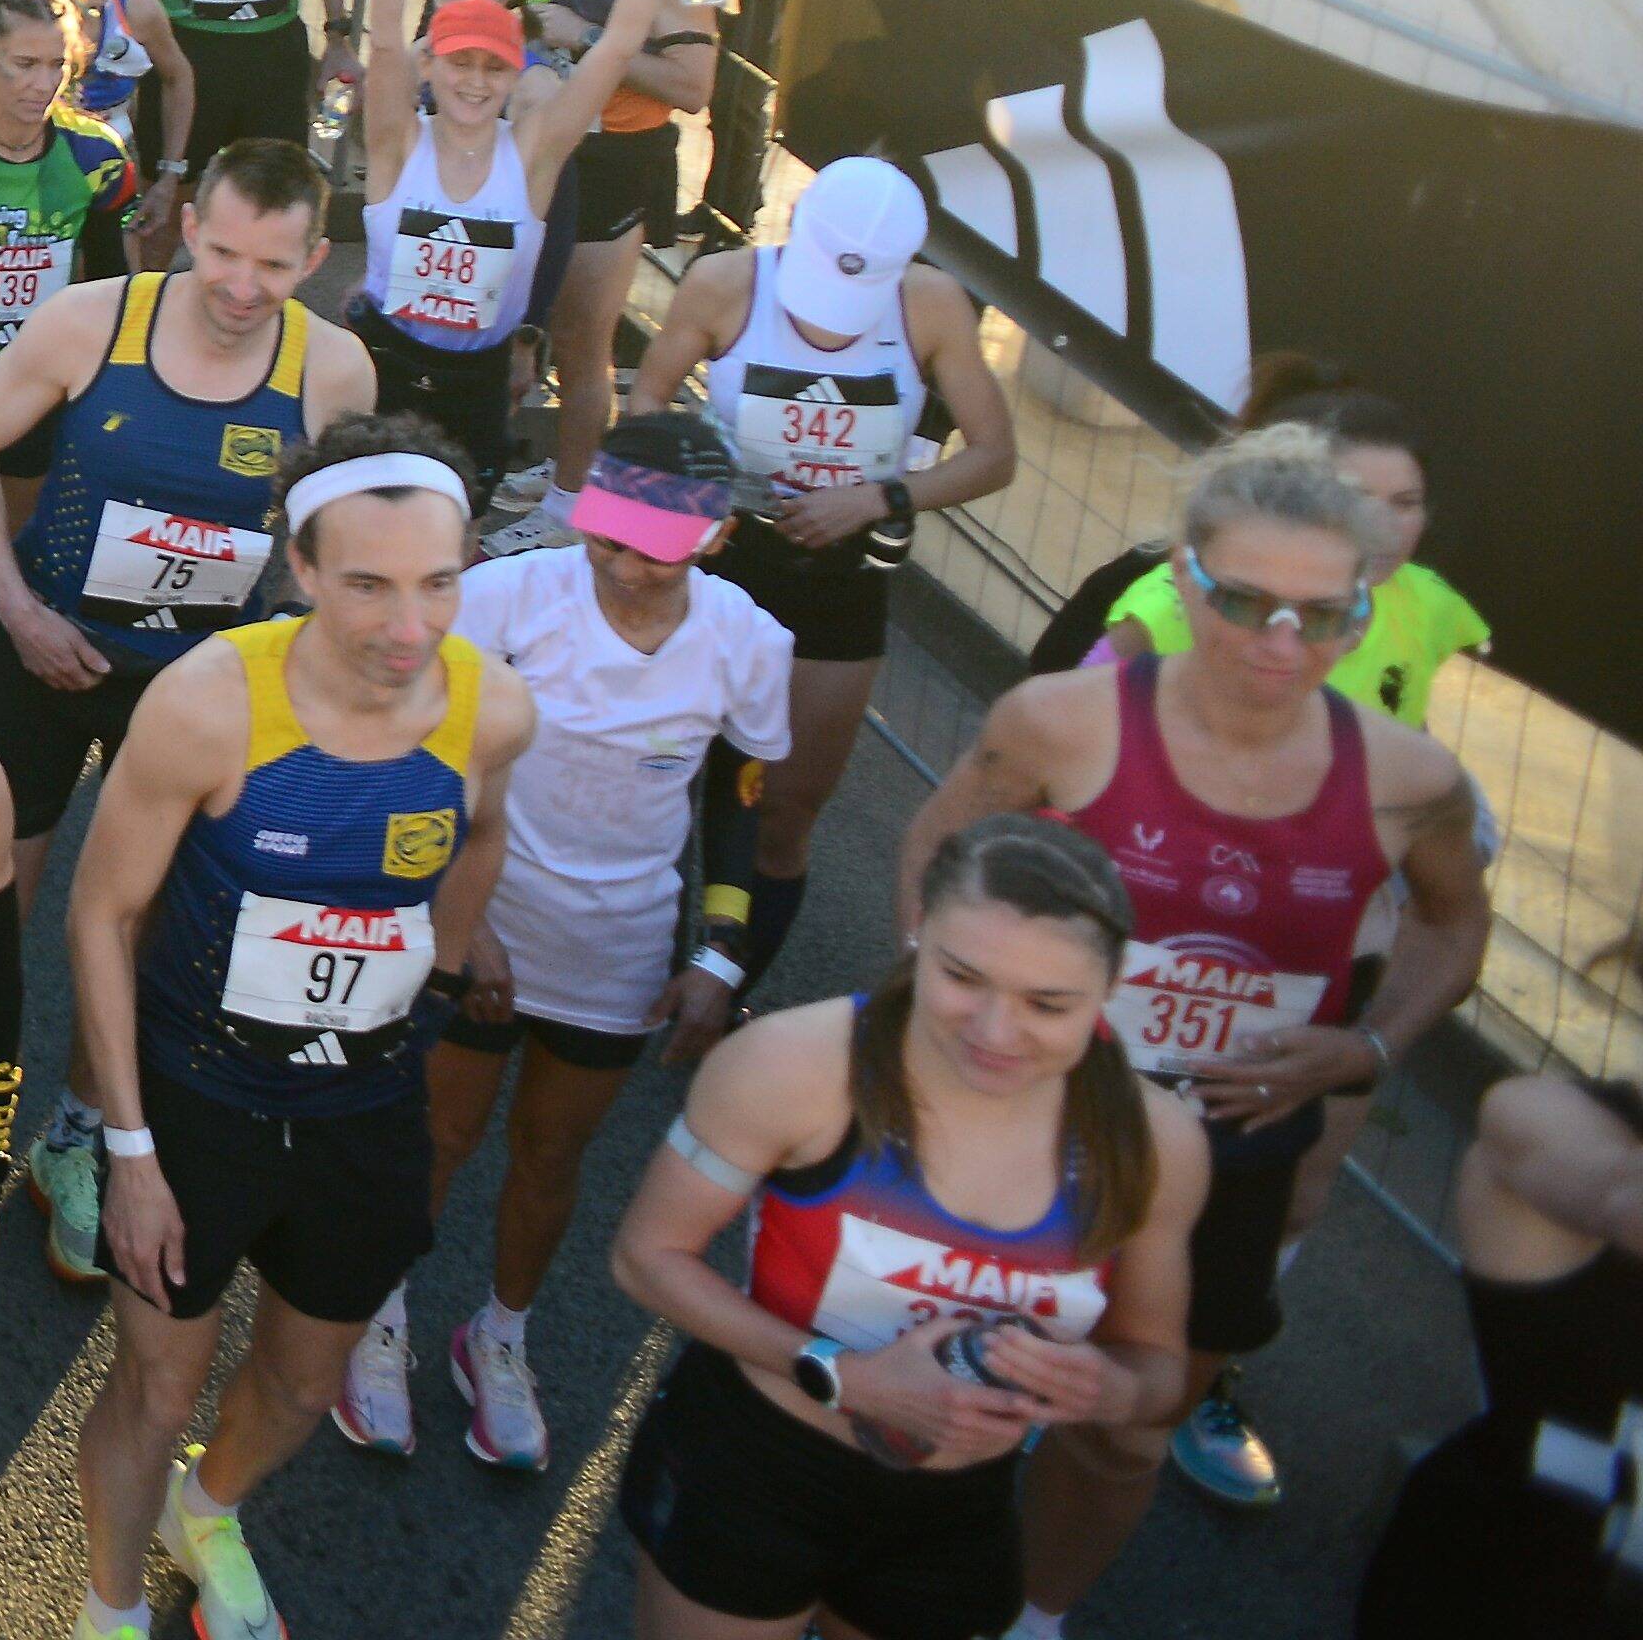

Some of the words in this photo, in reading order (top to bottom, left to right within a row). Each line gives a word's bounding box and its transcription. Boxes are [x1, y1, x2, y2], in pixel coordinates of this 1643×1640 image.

[415, 241, 477, 284] 348
[782, 403, 857, 449] 342
[147, 520, 236, 557] MAIF
[149, 554, 196, 590] 75
[299, 915, 405, 946] MAIF
[304, 951, 367, 1005] 97
[1155, 959, 1274, 999] MAIF
[1141, 992, 1236, 1053] 351
[915, 1254, 1059, 1310] MAIF
